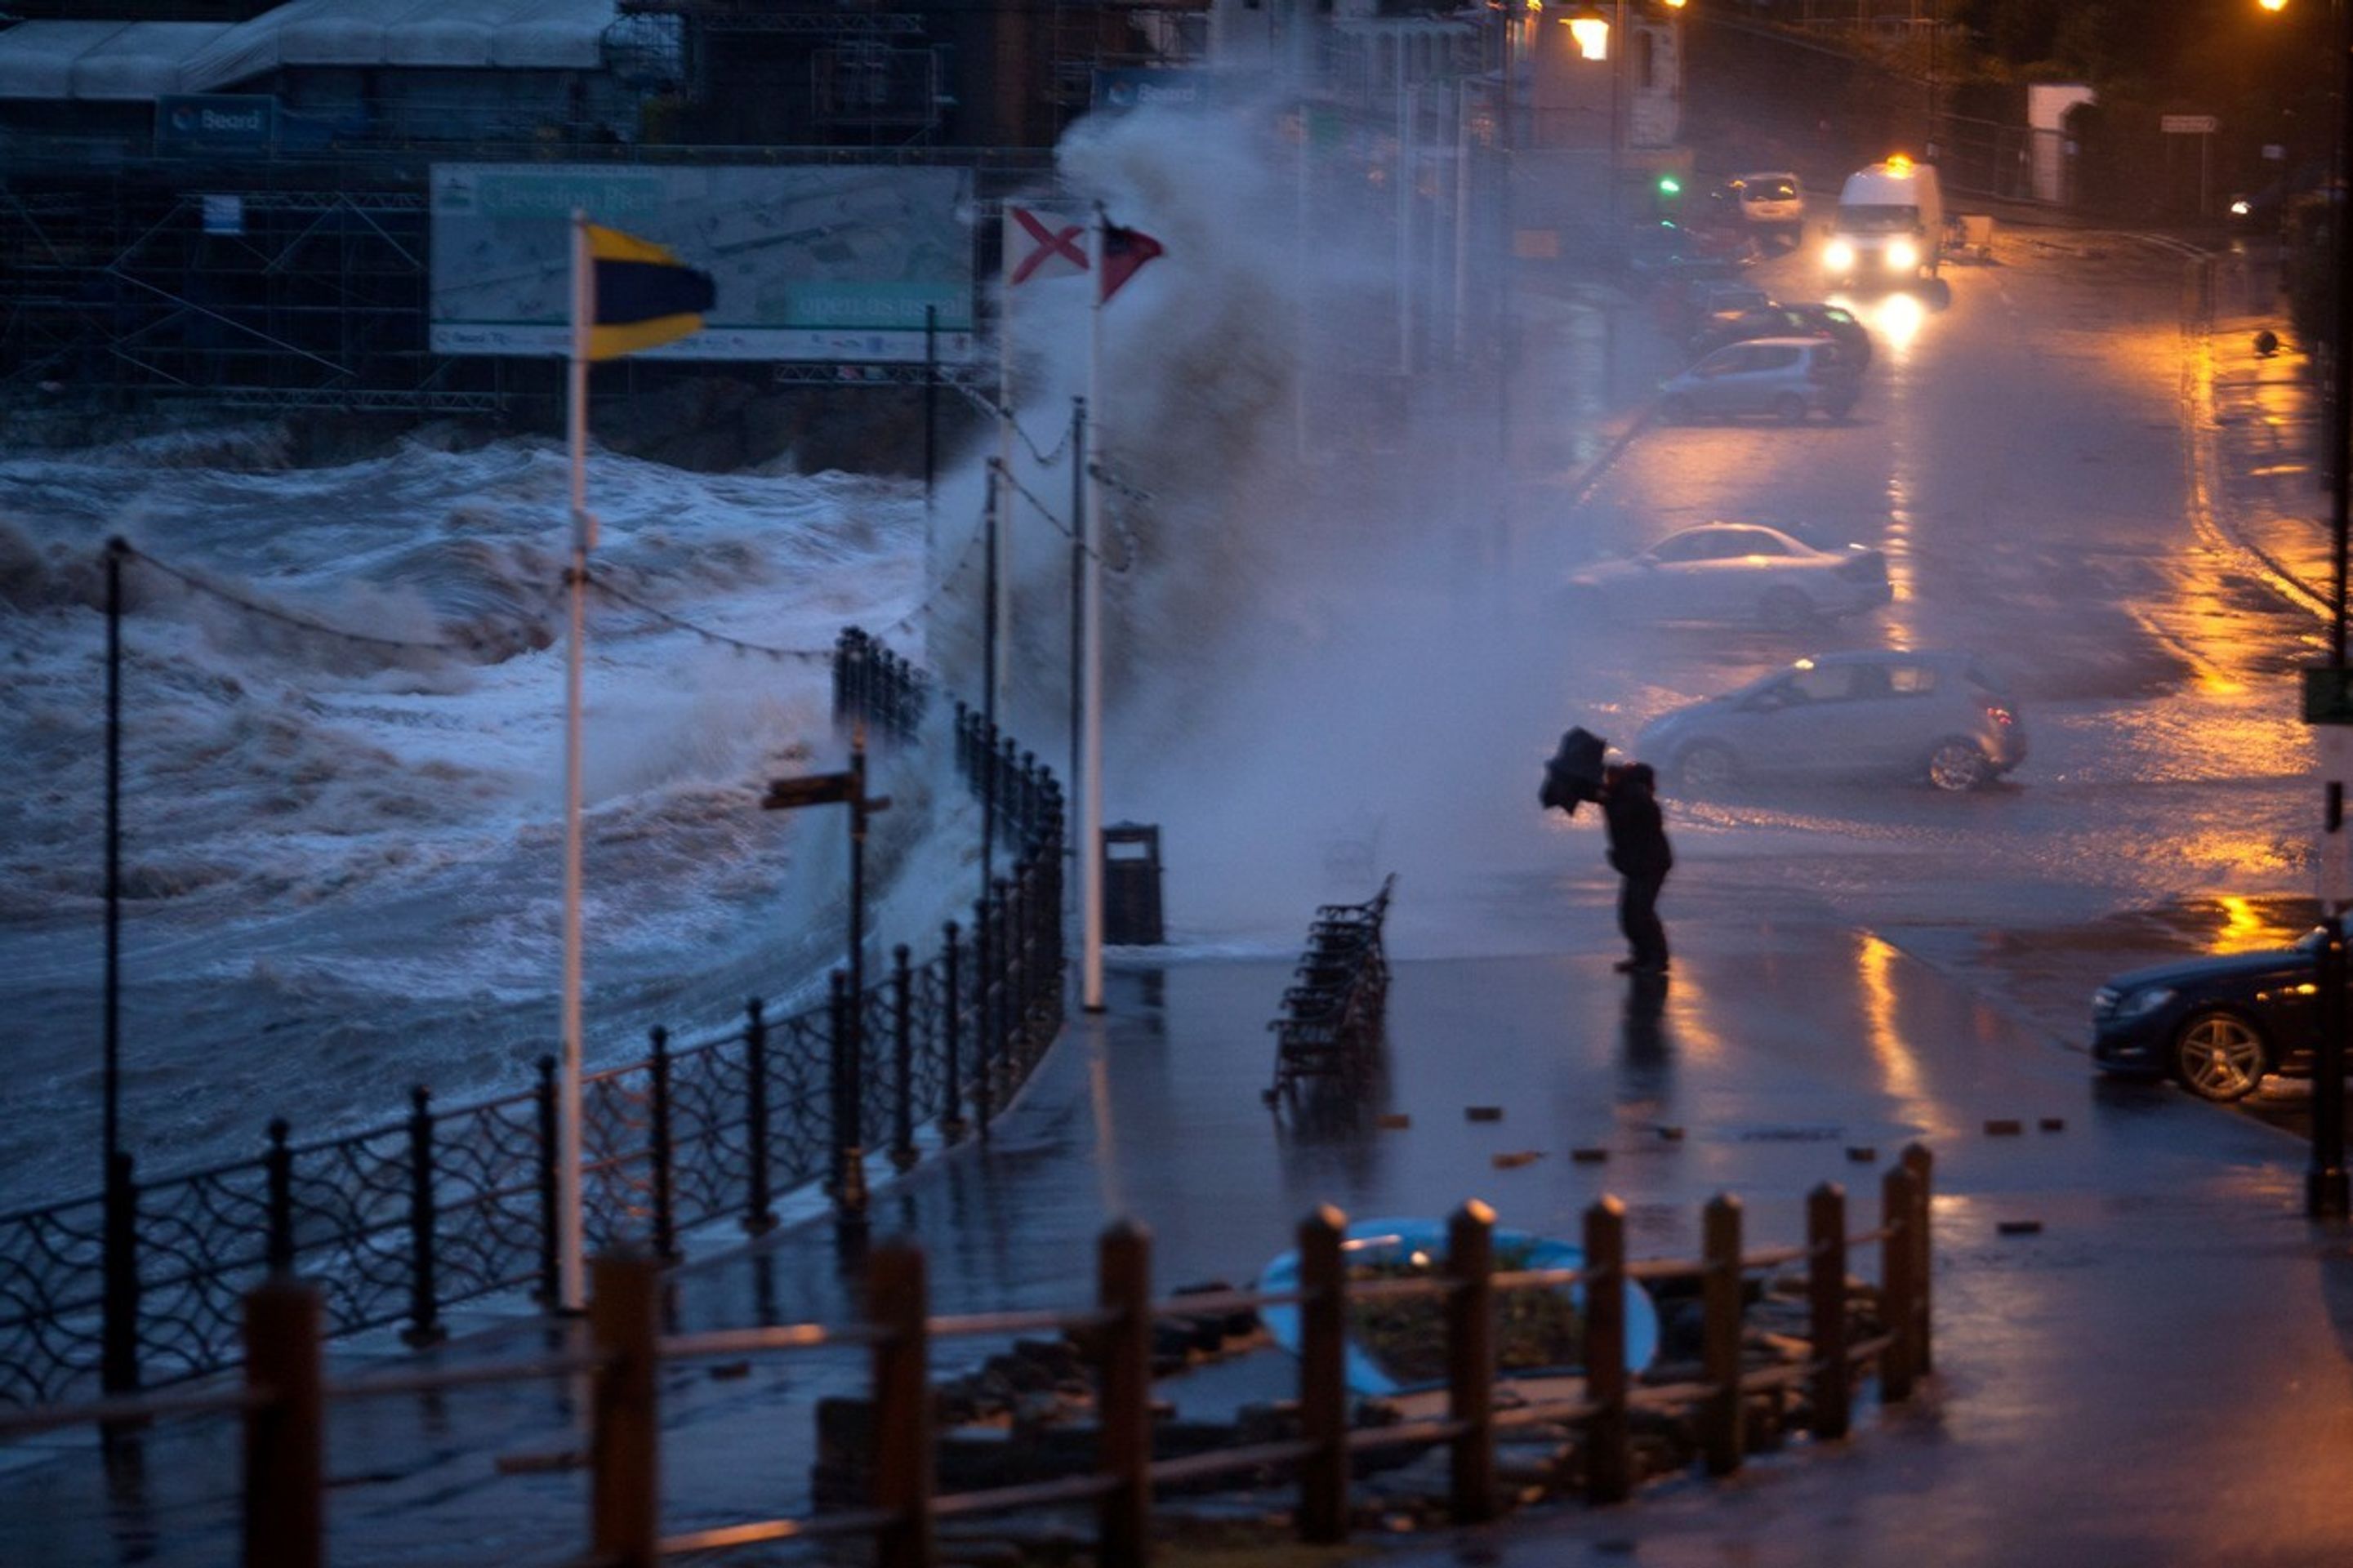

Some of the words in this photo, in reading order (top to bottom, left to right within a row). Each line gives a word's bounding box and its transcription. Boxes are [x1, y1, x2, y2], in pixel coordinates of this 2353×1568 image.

[201, 108, 260, 130] Beard
[483, 181, 598, 209] Clevedon
[603, 185, 658, 210] Pier
[800, 296, 861, 323] open
[867, 297, 894, 318] as
